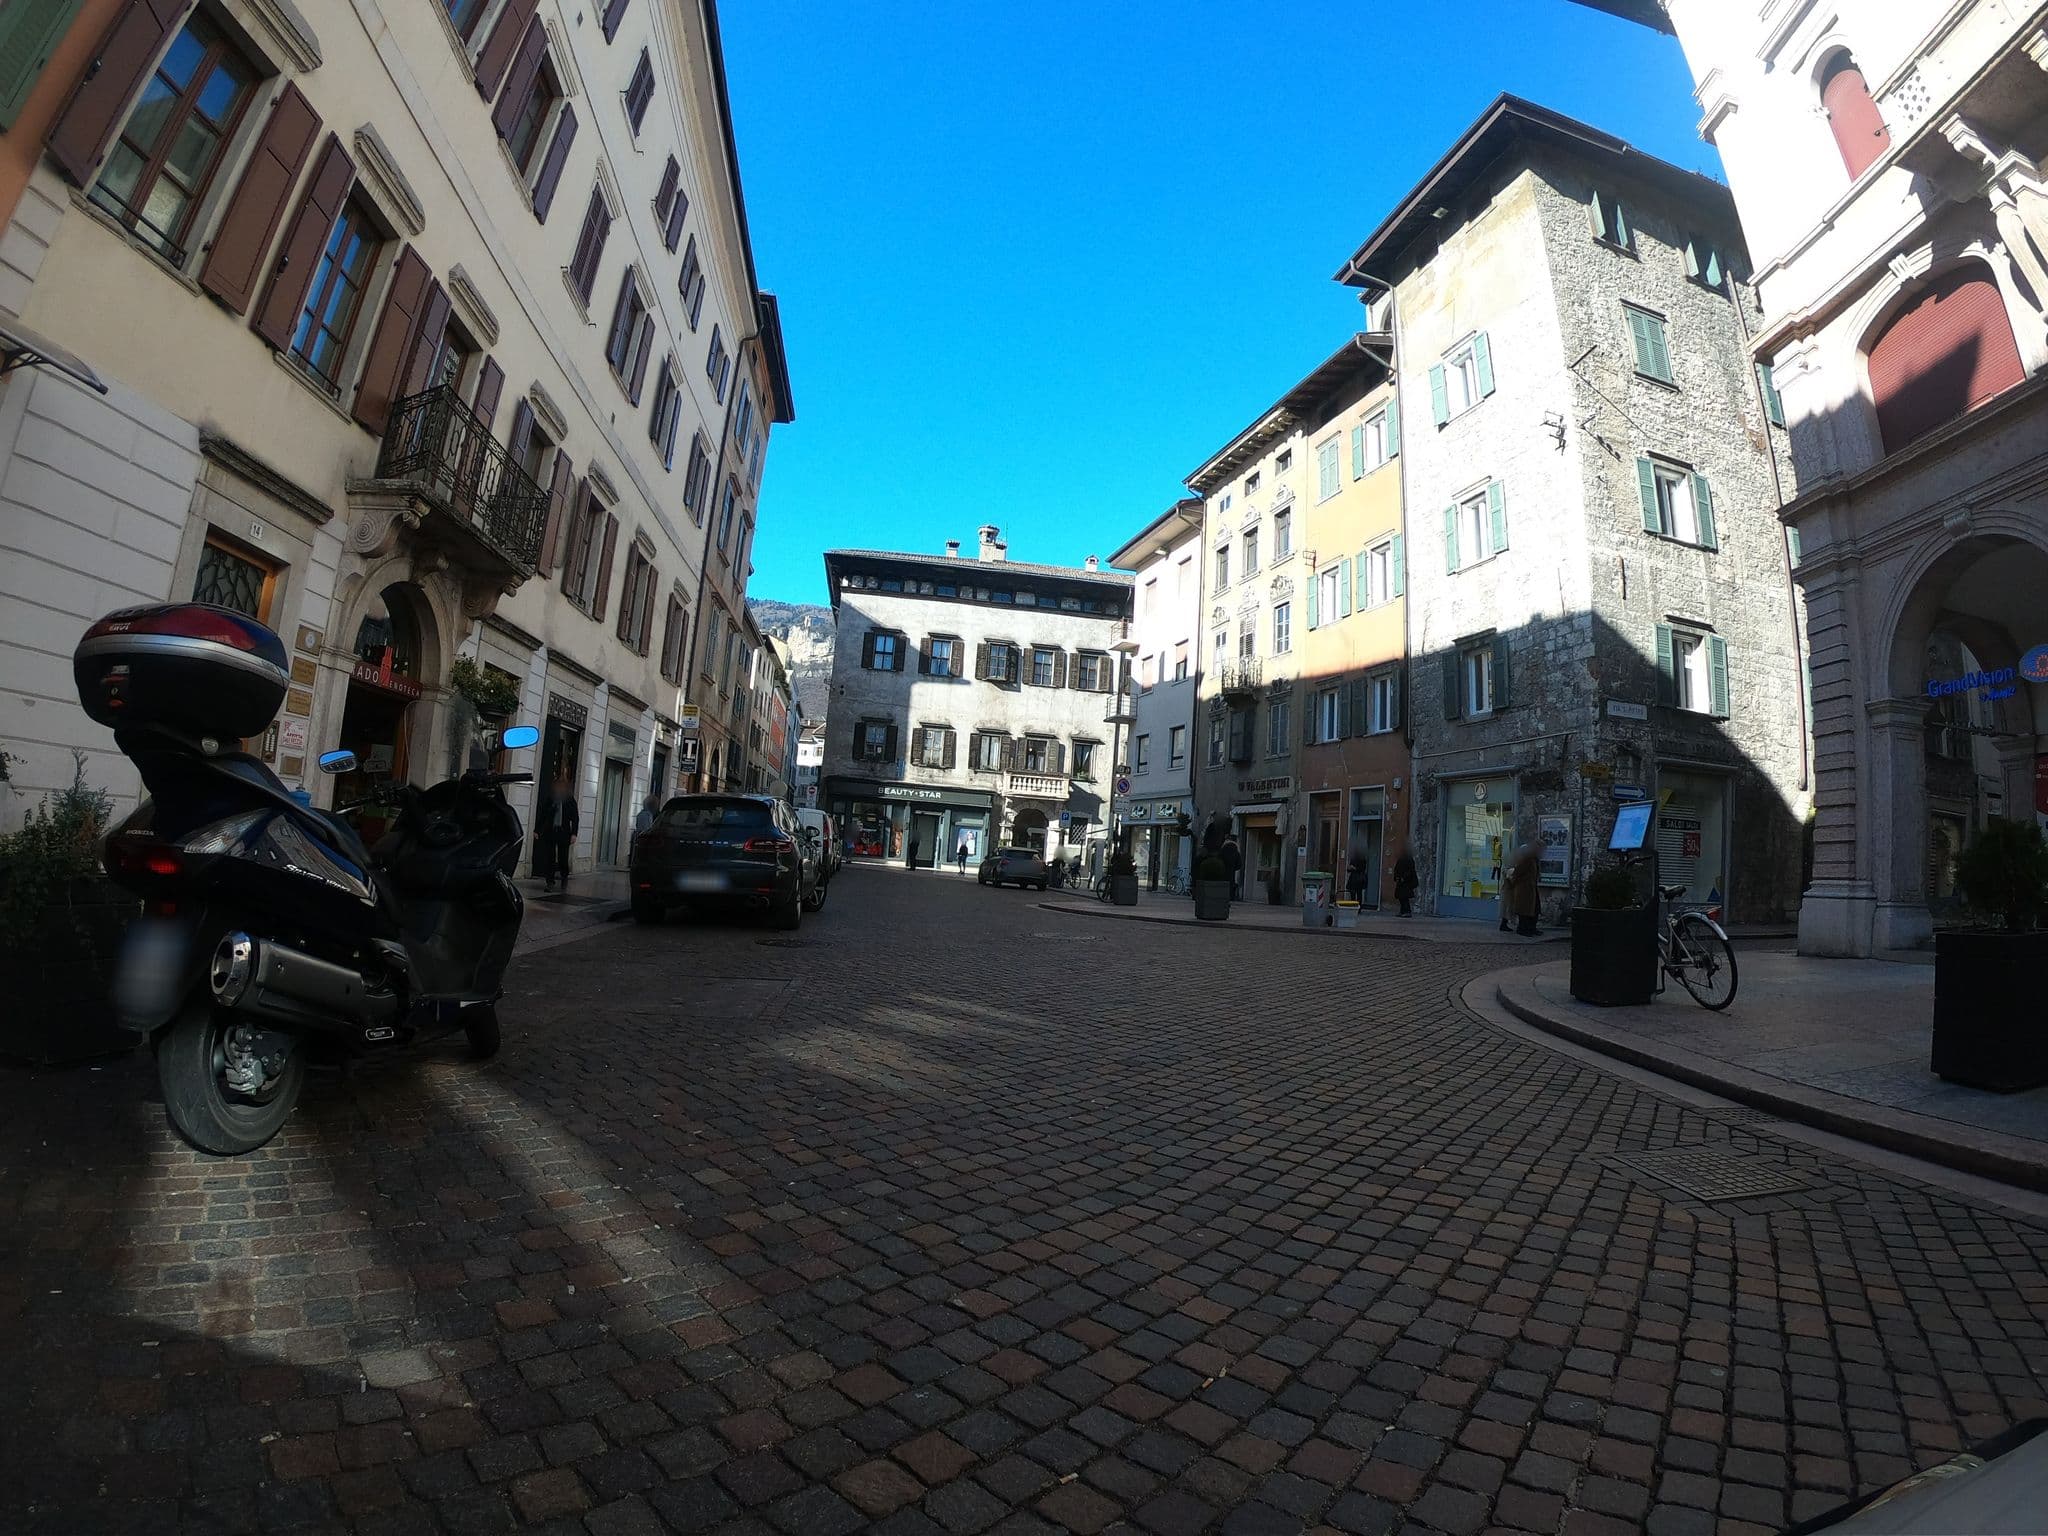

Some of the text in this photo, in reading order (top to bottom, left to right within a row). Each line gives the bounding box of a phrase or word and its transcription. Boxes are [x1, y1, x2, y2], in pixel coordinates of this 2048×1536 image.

[253, 525, 261, 537] 14
[878, 787, 941, 799] BEAUTY STAR
